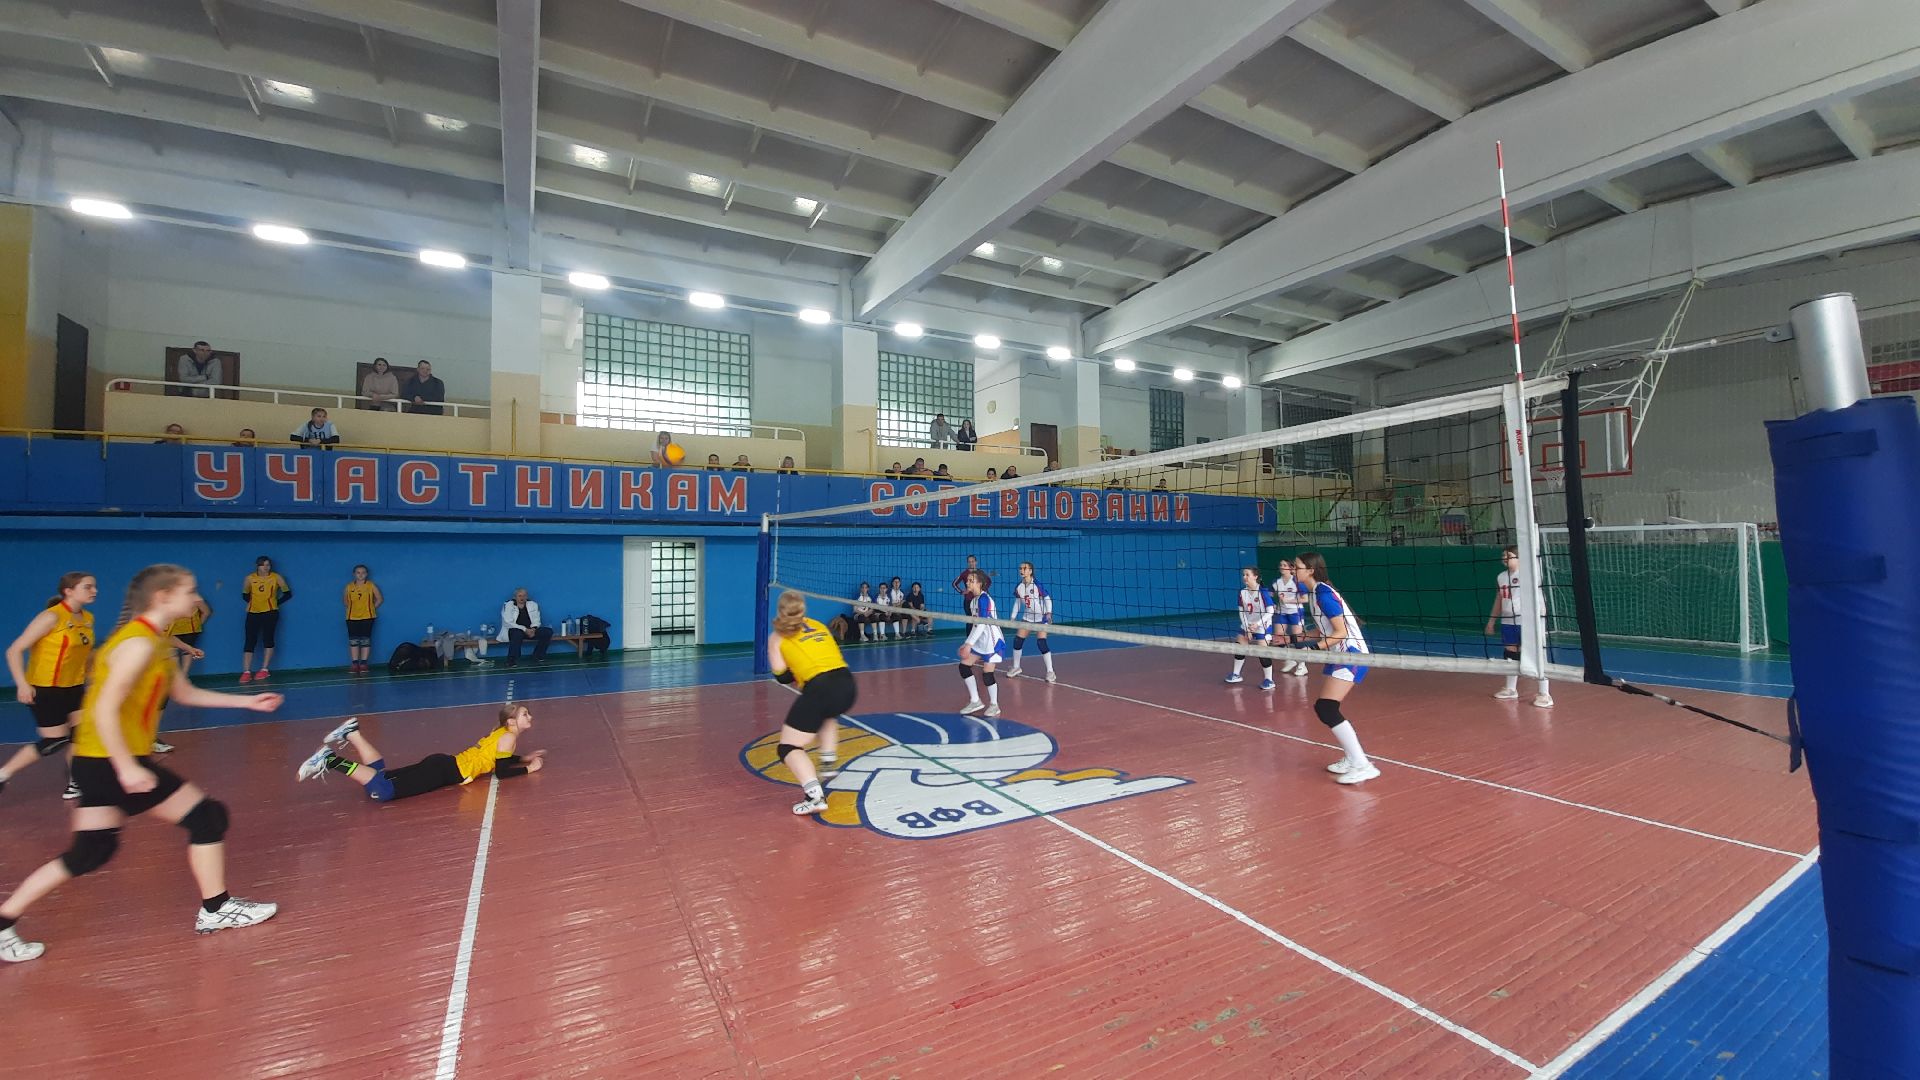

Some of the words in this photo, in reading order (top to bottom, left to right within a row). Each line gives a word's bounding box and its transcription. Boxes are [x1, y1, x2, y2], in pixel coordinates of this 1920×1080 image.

[193, 451, 749, 516] УЧАСТНИКАМ
[870, 481, 1192, 523] СОРЕВНОВАНИЙ
[1256, 500, 1264, 525] !
[896, 799, 1003, 829] ВФВ
